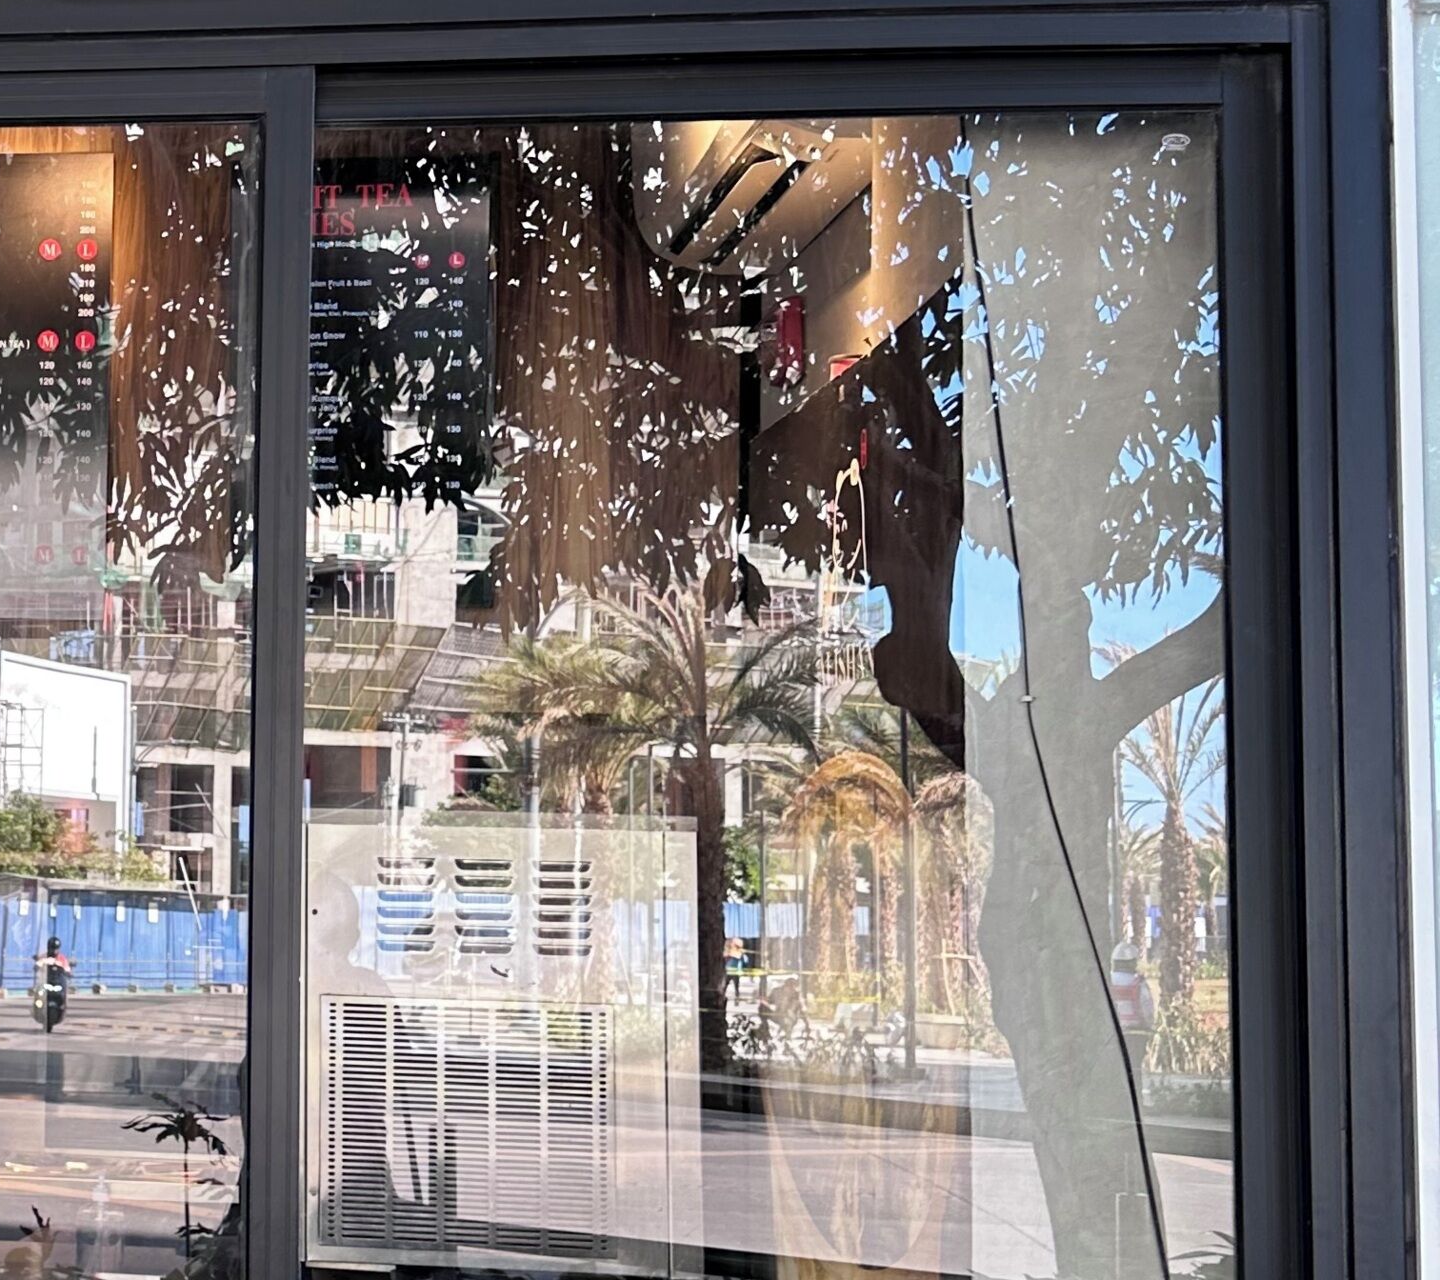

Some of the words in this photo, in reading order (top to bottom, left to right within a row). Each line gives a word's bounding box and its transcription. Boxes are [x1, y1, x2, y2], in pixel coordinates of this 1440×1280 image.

[356, 183, 413, 208] TEA
[414, 330, 429, 339] 110
[39, 360, 56, 370] 120
[76, 360, 93, 370] 140
[39, 376, 55, 386] 120
[76, 376, 92, 386] 140
